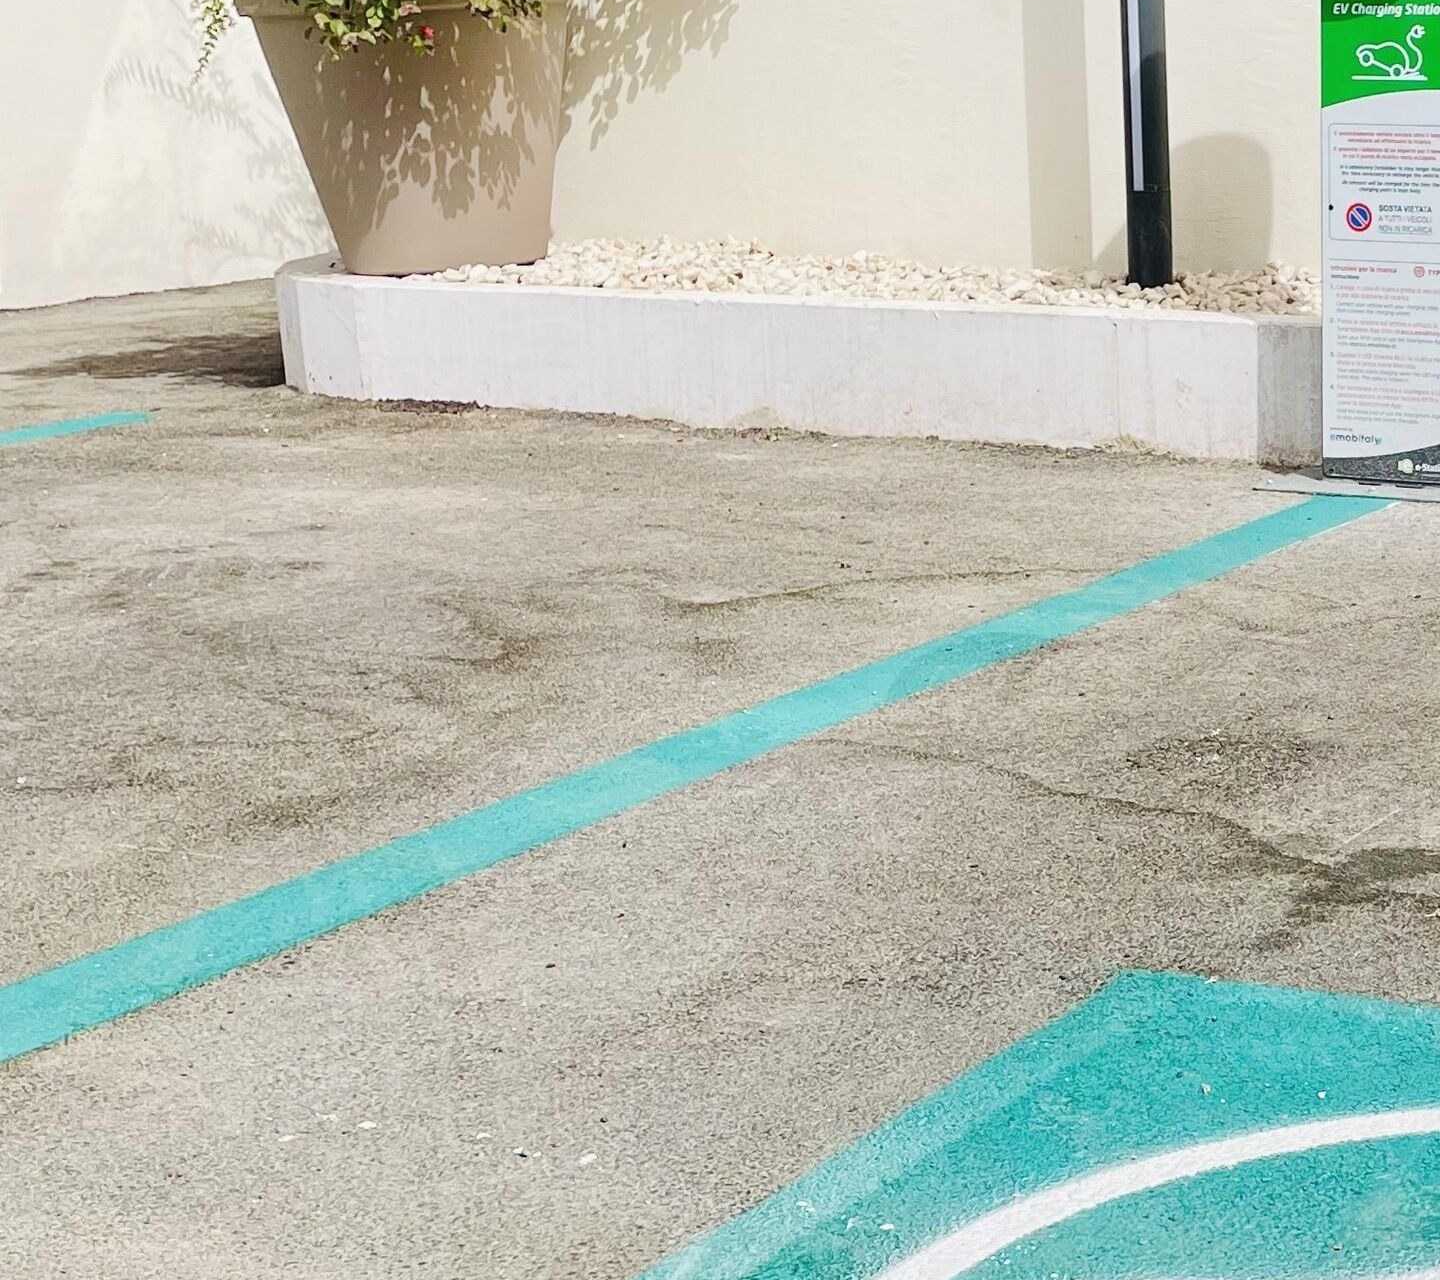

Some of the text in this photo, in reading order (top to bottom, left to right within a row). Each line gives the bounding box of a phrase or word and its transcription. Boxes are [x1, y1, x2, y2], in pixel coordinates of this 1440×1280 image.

[1333, 2, 1349, 15] EV
[1351, 2, 1403, 17] Charging
[1378, 204, 1432, 213] SOSTA VIETATA
[1330, 433, 1381, 445] emobitaly
